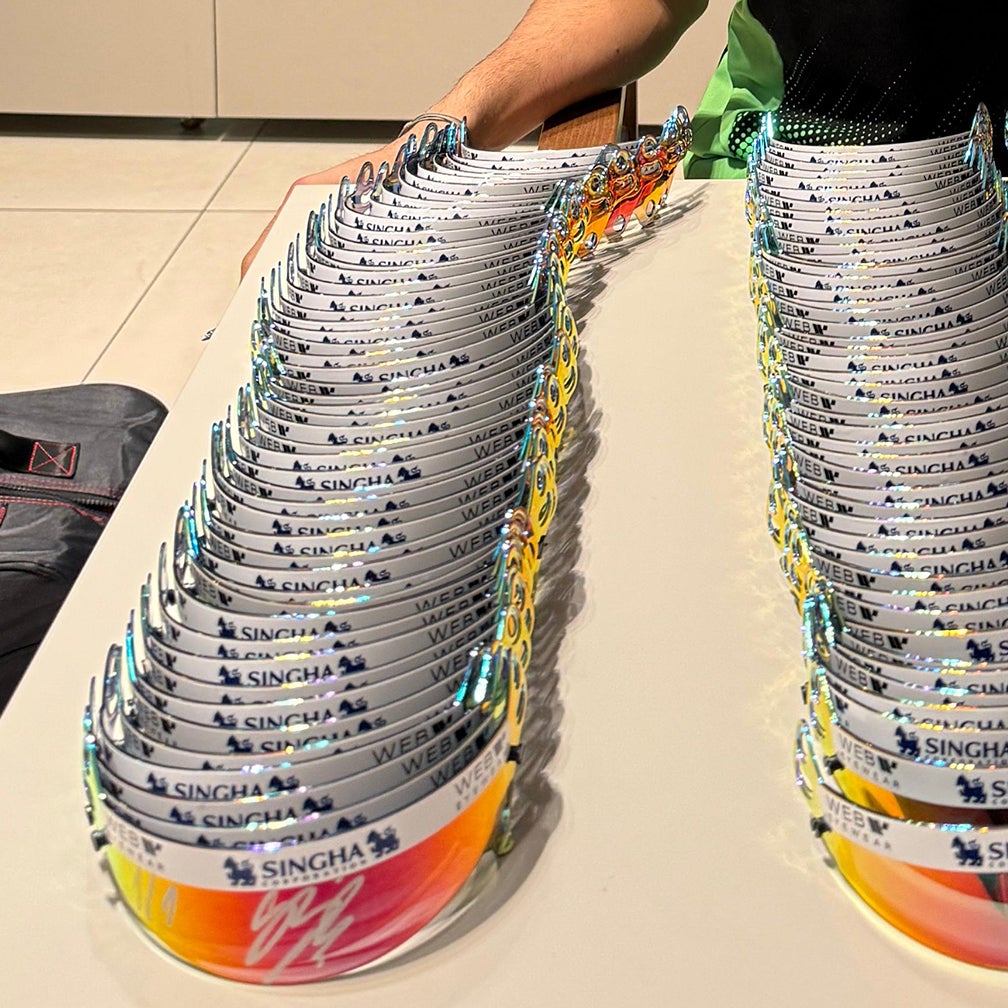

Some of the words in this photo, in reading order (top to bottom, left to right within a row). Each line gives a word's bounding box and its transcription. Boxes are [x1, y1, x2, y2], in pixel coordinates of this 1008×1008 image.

[953, 200, 976, 216] WEB
[986, 274, 1008, 296] WEB
[510, 320, 537, 343] WEB
[783, 318, 810, 332] WEB
[880, 388, 945, 400] SINGHA
[790, 417, 817, 434] WEB
[895, 459, 965, 475] SINGHA
[320, 474, 394, 491] SINGHA
[818, 561, 854, 583] WEB
[920, 558, 998, 575] SINGHA
[248, 665, 334, 687] SINGHA
[401, 741, 450, 776] WEB
[840, 734, 875, 767] WEB
[455, 753, 492, 795] WEB
[173, 781, 263, 802] SINGHA
[827, 795, 864, 828] WEB
[261, 843, 363, 879] SINGHA
